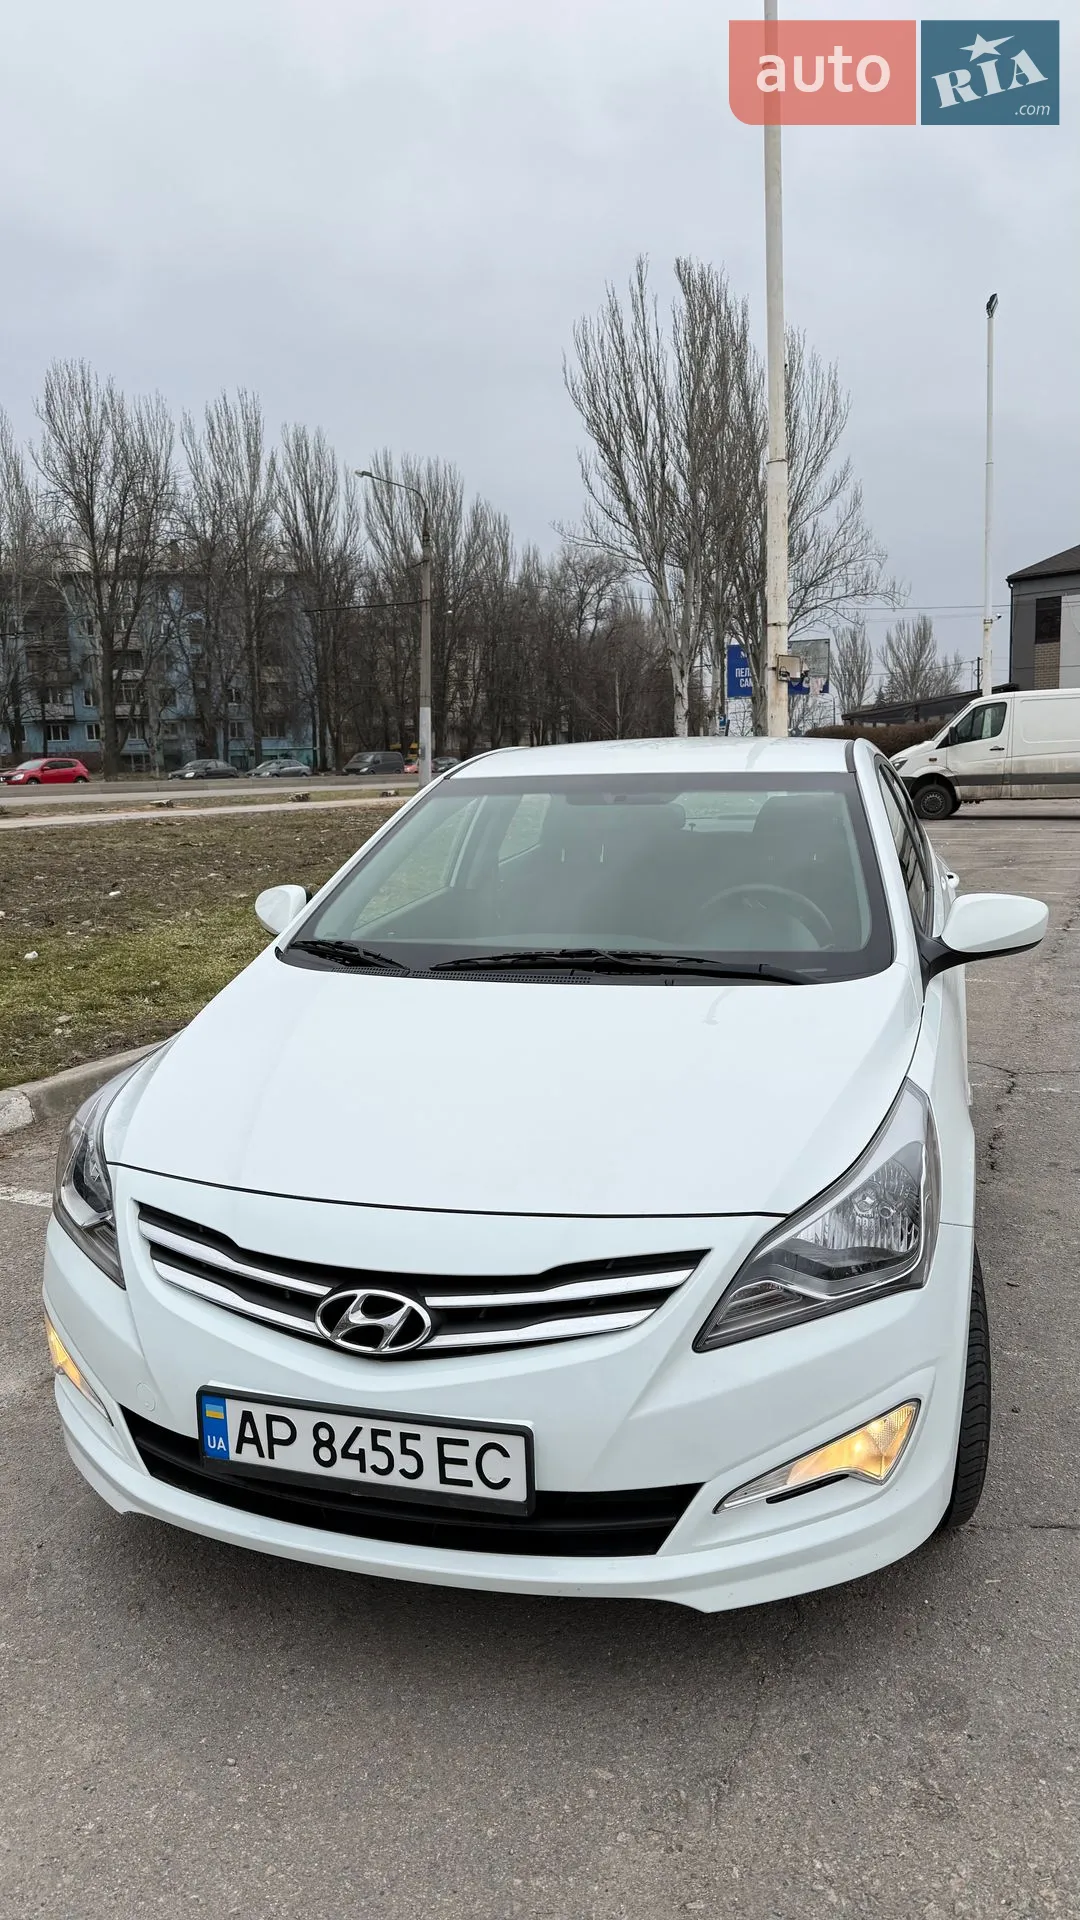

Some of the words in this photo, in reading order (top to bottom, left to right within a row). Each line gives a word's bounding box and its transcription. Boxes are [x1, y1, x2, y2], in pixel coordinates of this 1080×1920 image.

[735, 668, 752, 677] ПЕЛ
[207, 1435, 227, 1451] UA
[235, 1410, 297, 1460] AP
[312, 1421, 424, 1480] 8455
[436, 1436, 512, 1490] EC
